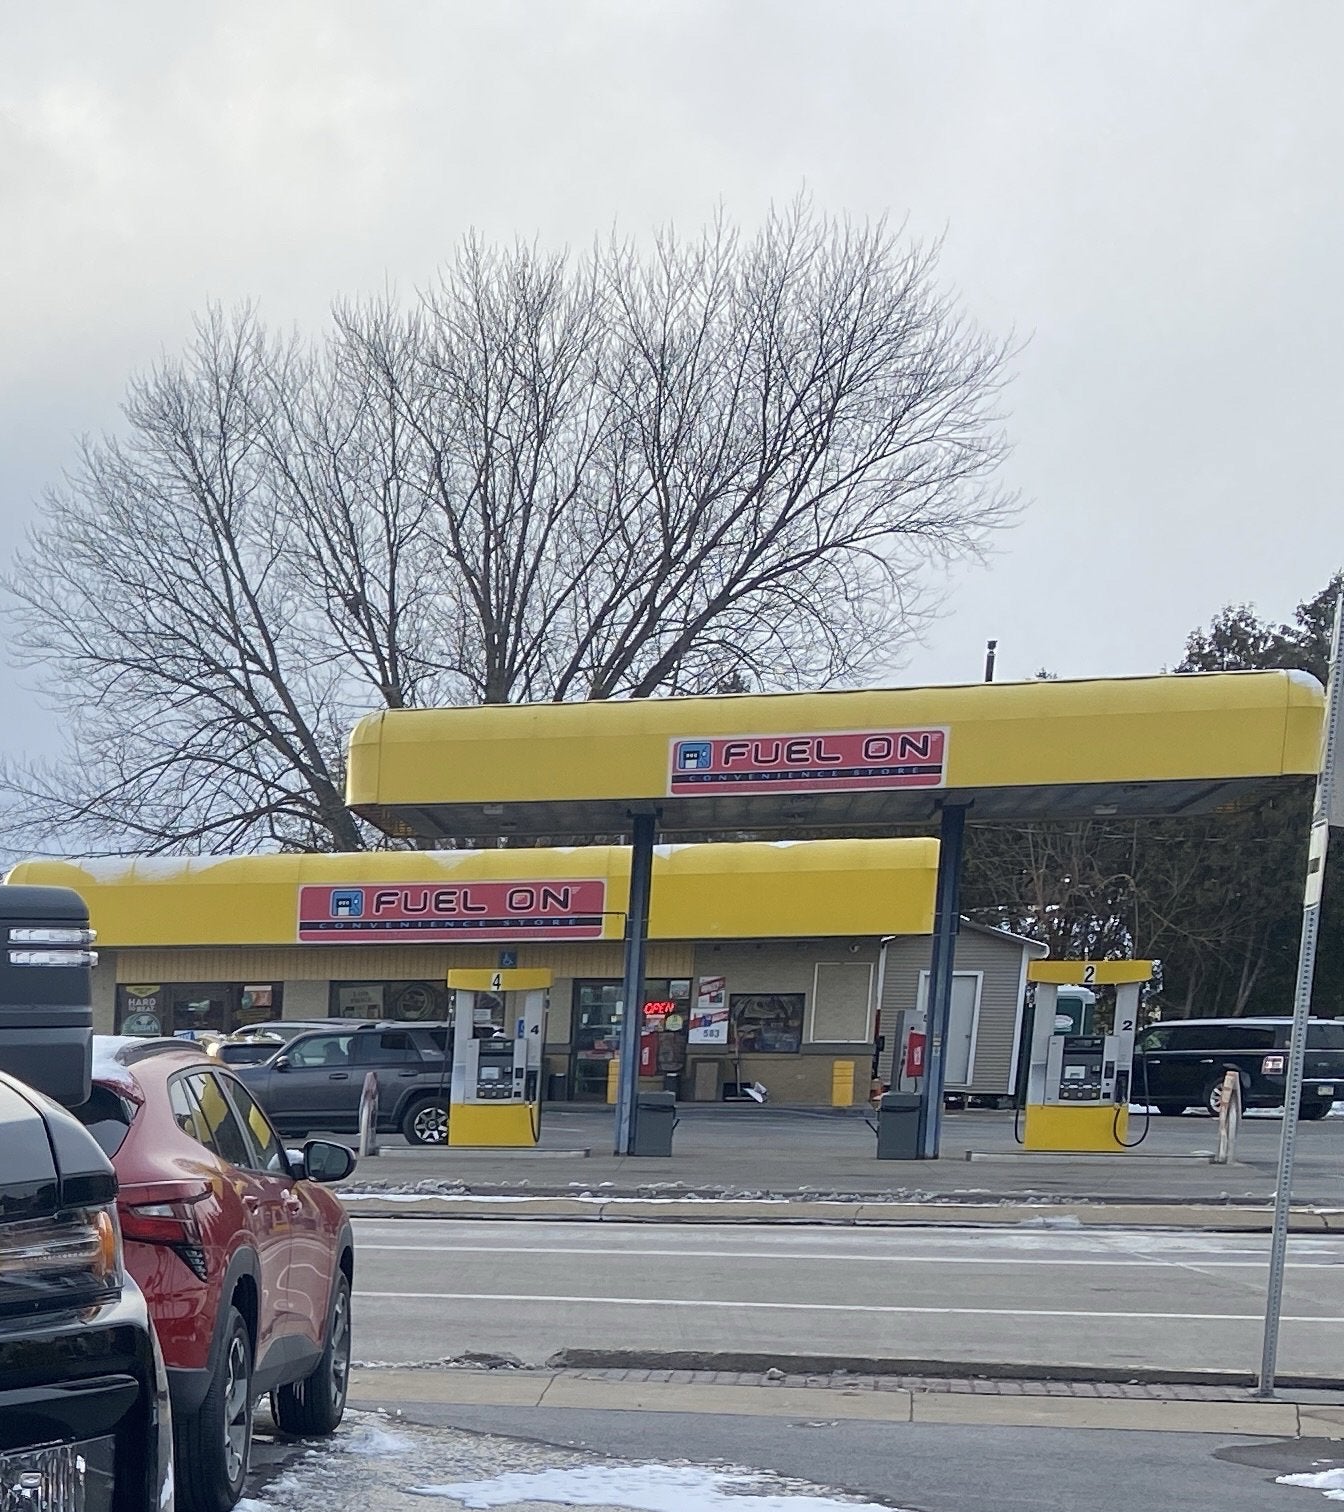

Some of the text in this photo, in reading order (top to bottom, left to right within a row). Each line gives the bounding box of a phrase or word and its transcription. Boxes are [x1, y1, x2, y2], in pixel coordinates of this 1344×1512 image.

[722, 733, 930, 766] FUEL ON
[688, 766, 919, 782] CONVENIENCE STORE
[373, 886, 572, 914] FUEL ON
[319, 918, 576, 929] CONVENIENCE STORE
[492, 974, 501, 990] 4
[1085, 966, 1095, 982] 2
[644, 1002, 674, 1014] OPEN
[531, 1025, 539, 1035] 4
[1122, 1020, 1133, 1031] 2
